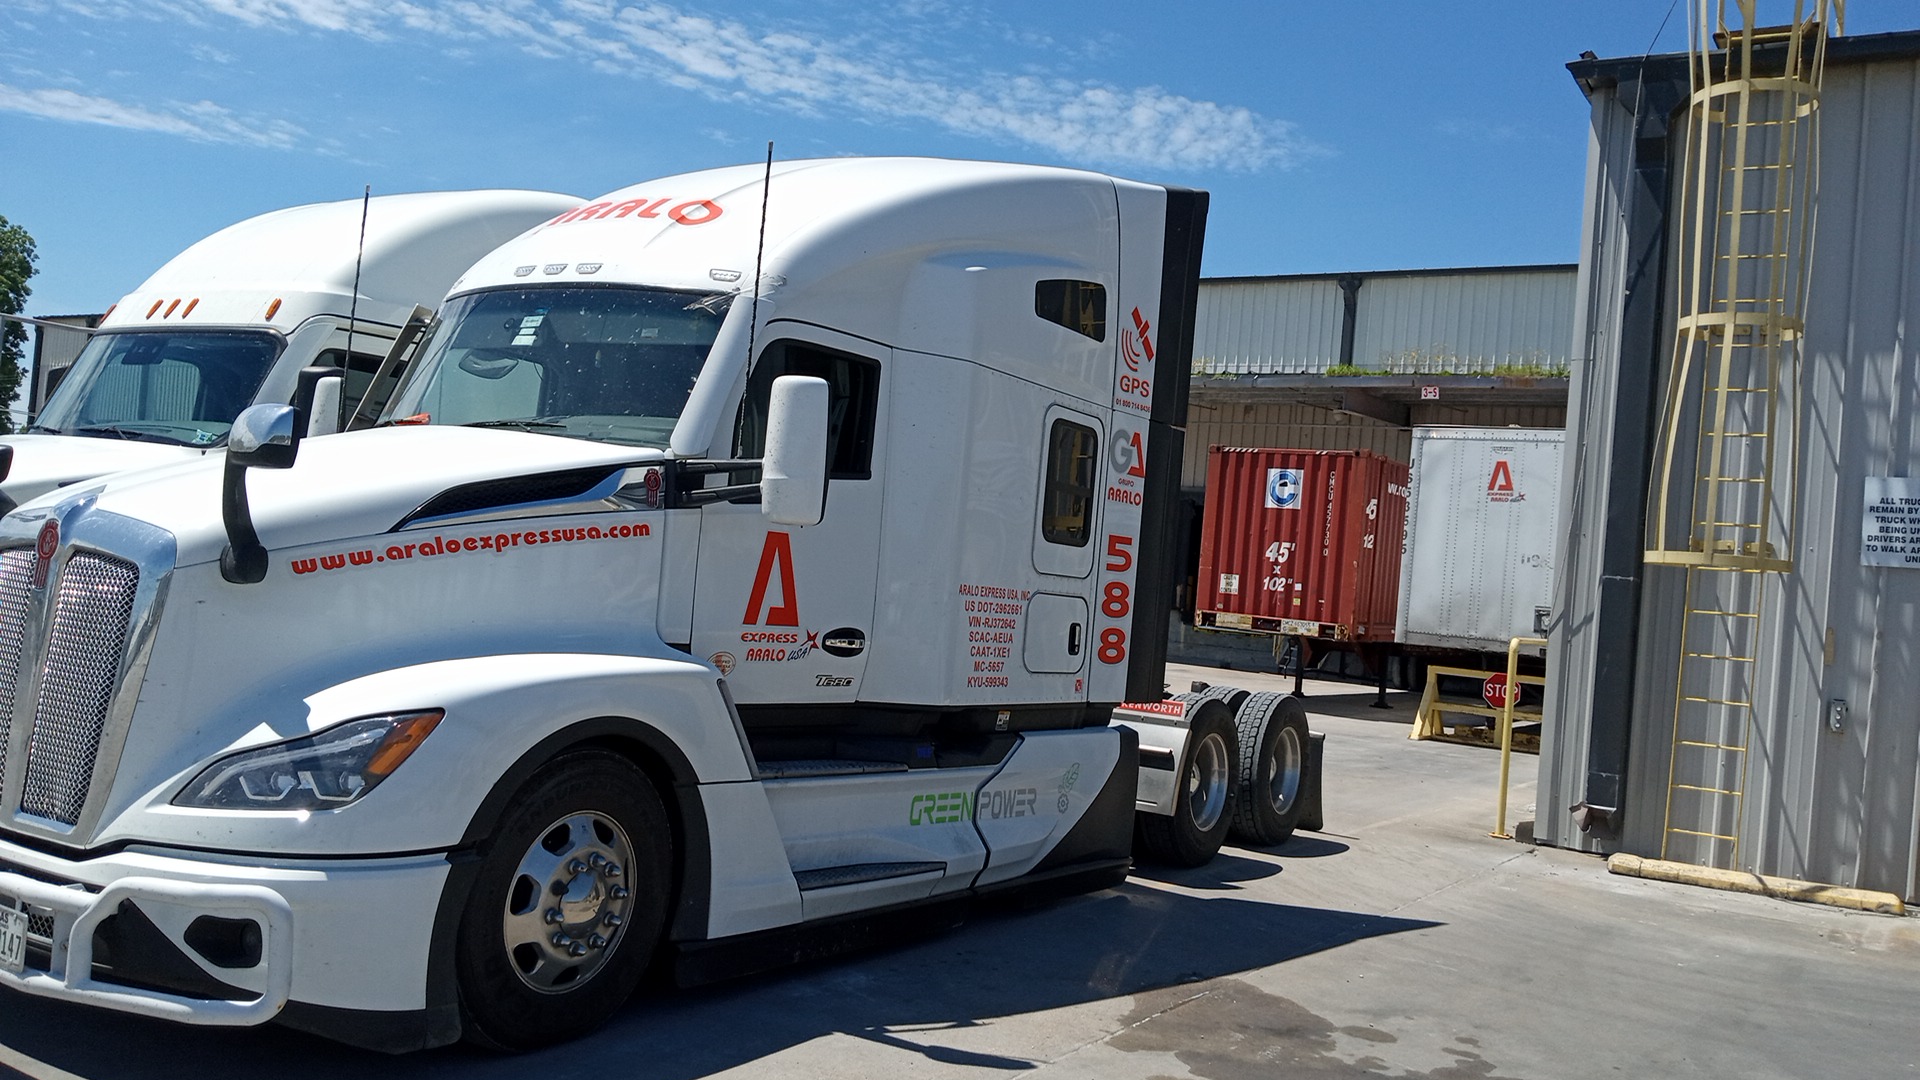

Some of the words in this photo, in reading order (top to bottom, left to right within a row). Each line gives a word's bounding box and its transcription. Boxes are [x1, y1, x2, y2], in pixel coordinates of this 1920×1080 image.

[1120, 375, 1149, 397] GPS
[1108, 487, 1142, 506] ARALO
[1879, 497, 1896, 505] ALL
[1869, 506, 1905, 514] REMAIN
[1875, 516, 1906, 524] TRUCK
[1879, 526, 1907, 534] BEING
[1867, 535, 1907, 544] DRIVERS
[291, 522, 650, 574] www.araloexpressusa.com
[1881, 545, 1906, 553] WALK
[742, 531, 799, 627] A
[959, 584, 980, 597] ARALO
[981, 586, 1006, 599] EXPRESS
[965, 600, 975, 611] US
[977, 601, 1022, 615] DOT-2962661
[741, 633, 798, 643] EXPRESS
[968, 631, 1013, 644] SCAC-AEUA
[746, 649, 786, 662] ARALO
[787, 647, 808, 661] USA
[970, 646, 1010, 658] CAAT-1XE1
[974, 661, 1004, 672] MC-5657
[967, 677, 1009, 688] KYU-599343
[1121, 703, 1181, 714] KENWORTH
[910, 792, 974, 826] GREEN
[979, 788, 1036, 820] POWER
[0, 929, 22, 961] 147
